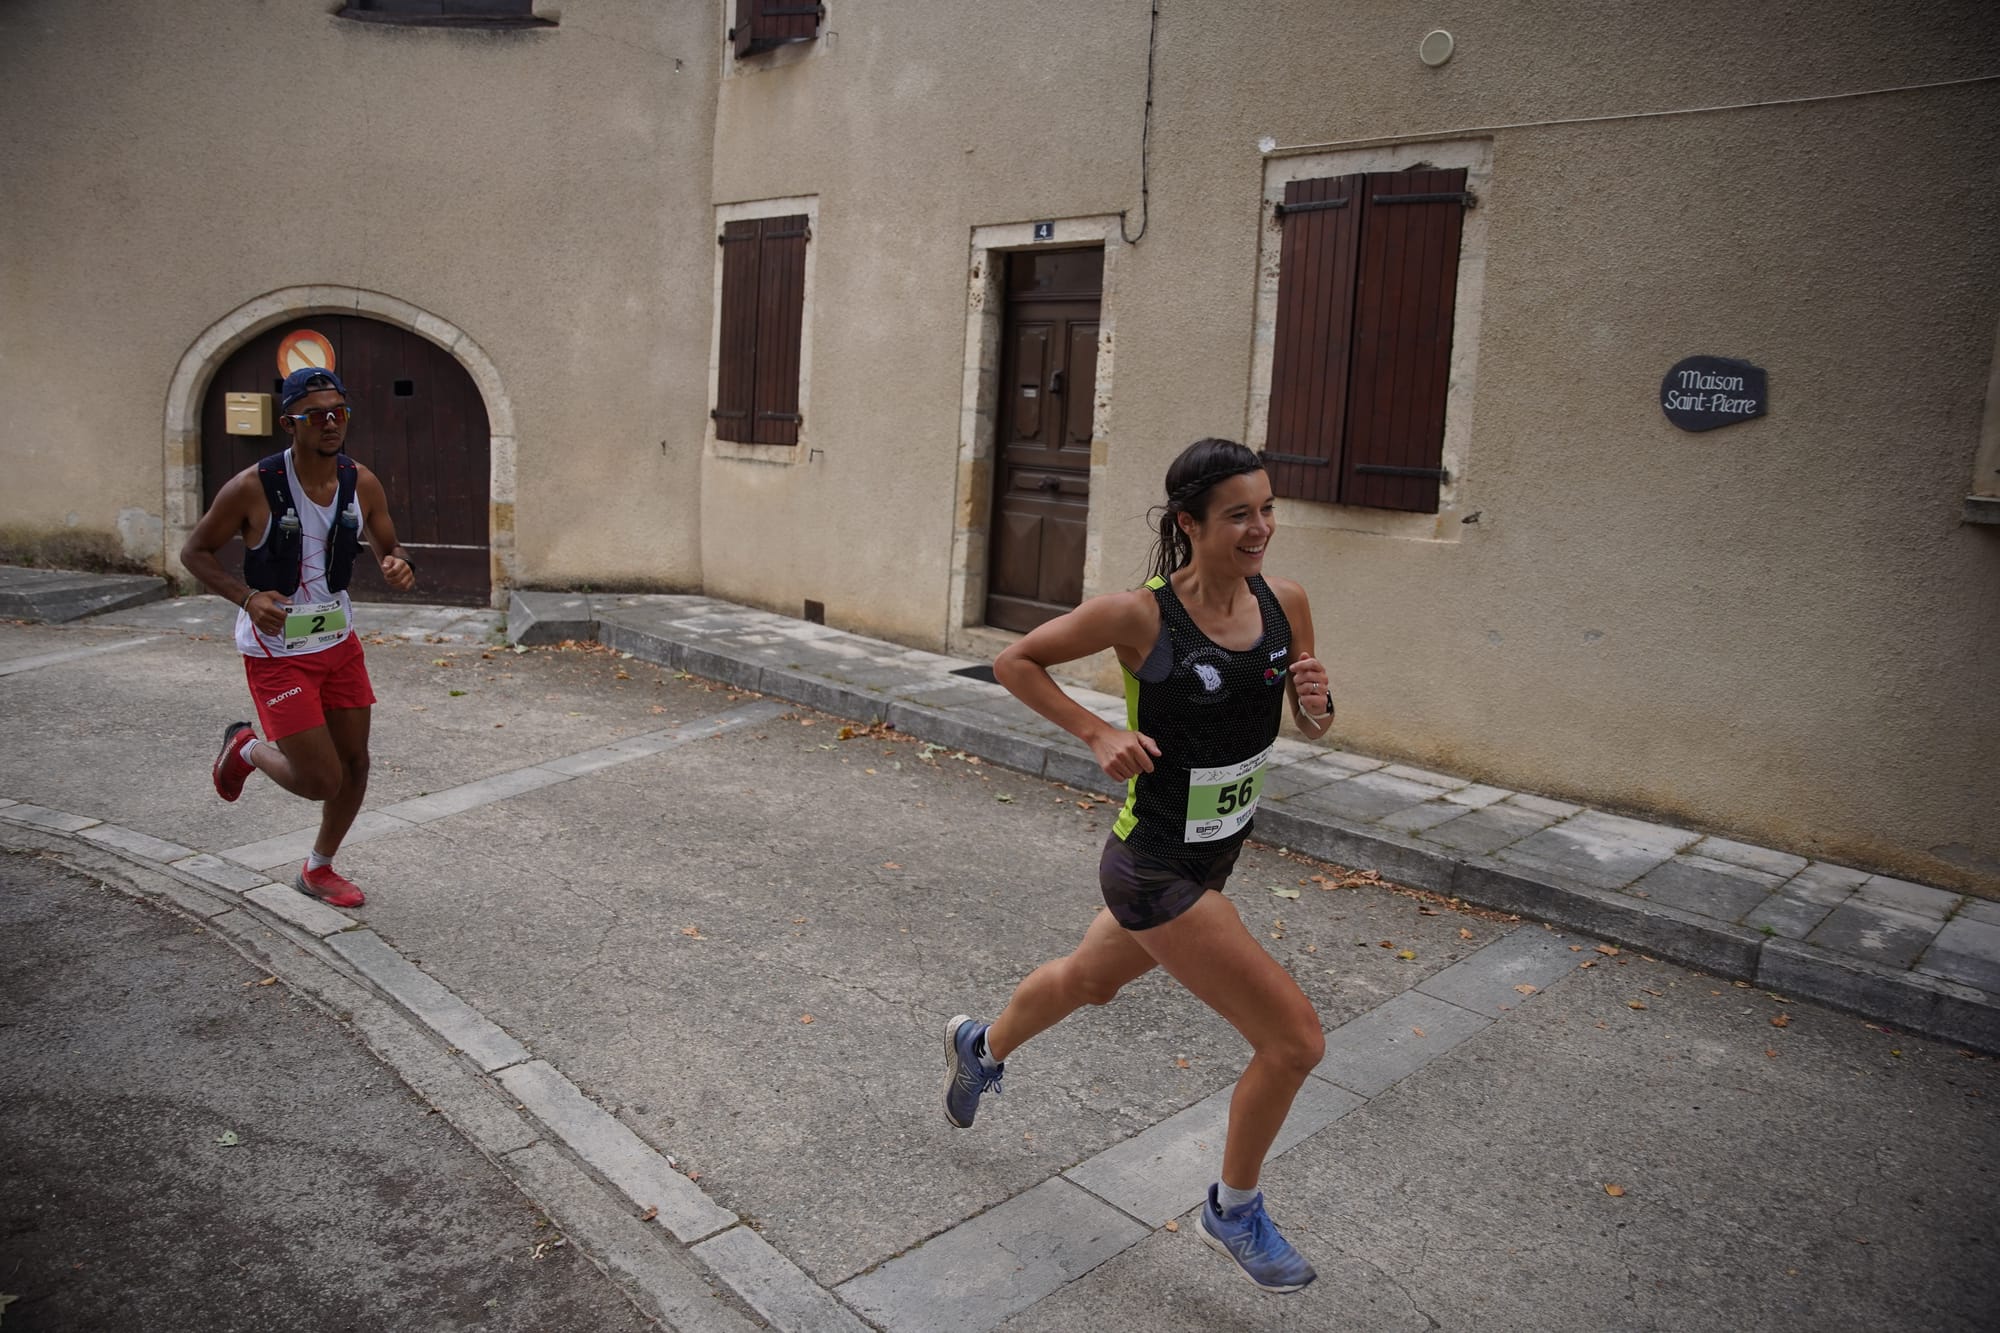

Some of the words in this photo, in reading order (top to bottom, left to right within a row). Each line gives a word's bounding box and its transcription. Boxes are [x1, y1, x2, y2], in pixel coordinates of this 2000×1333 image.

[1040, 225, 1047, 237] 4
[1679, 370, 1744, 391] Maison
[1664, 390, 1756, 414] Saint-Pierre
[311, 615, 326, 633] 2
[1216, 777, 1254, 815] 56
